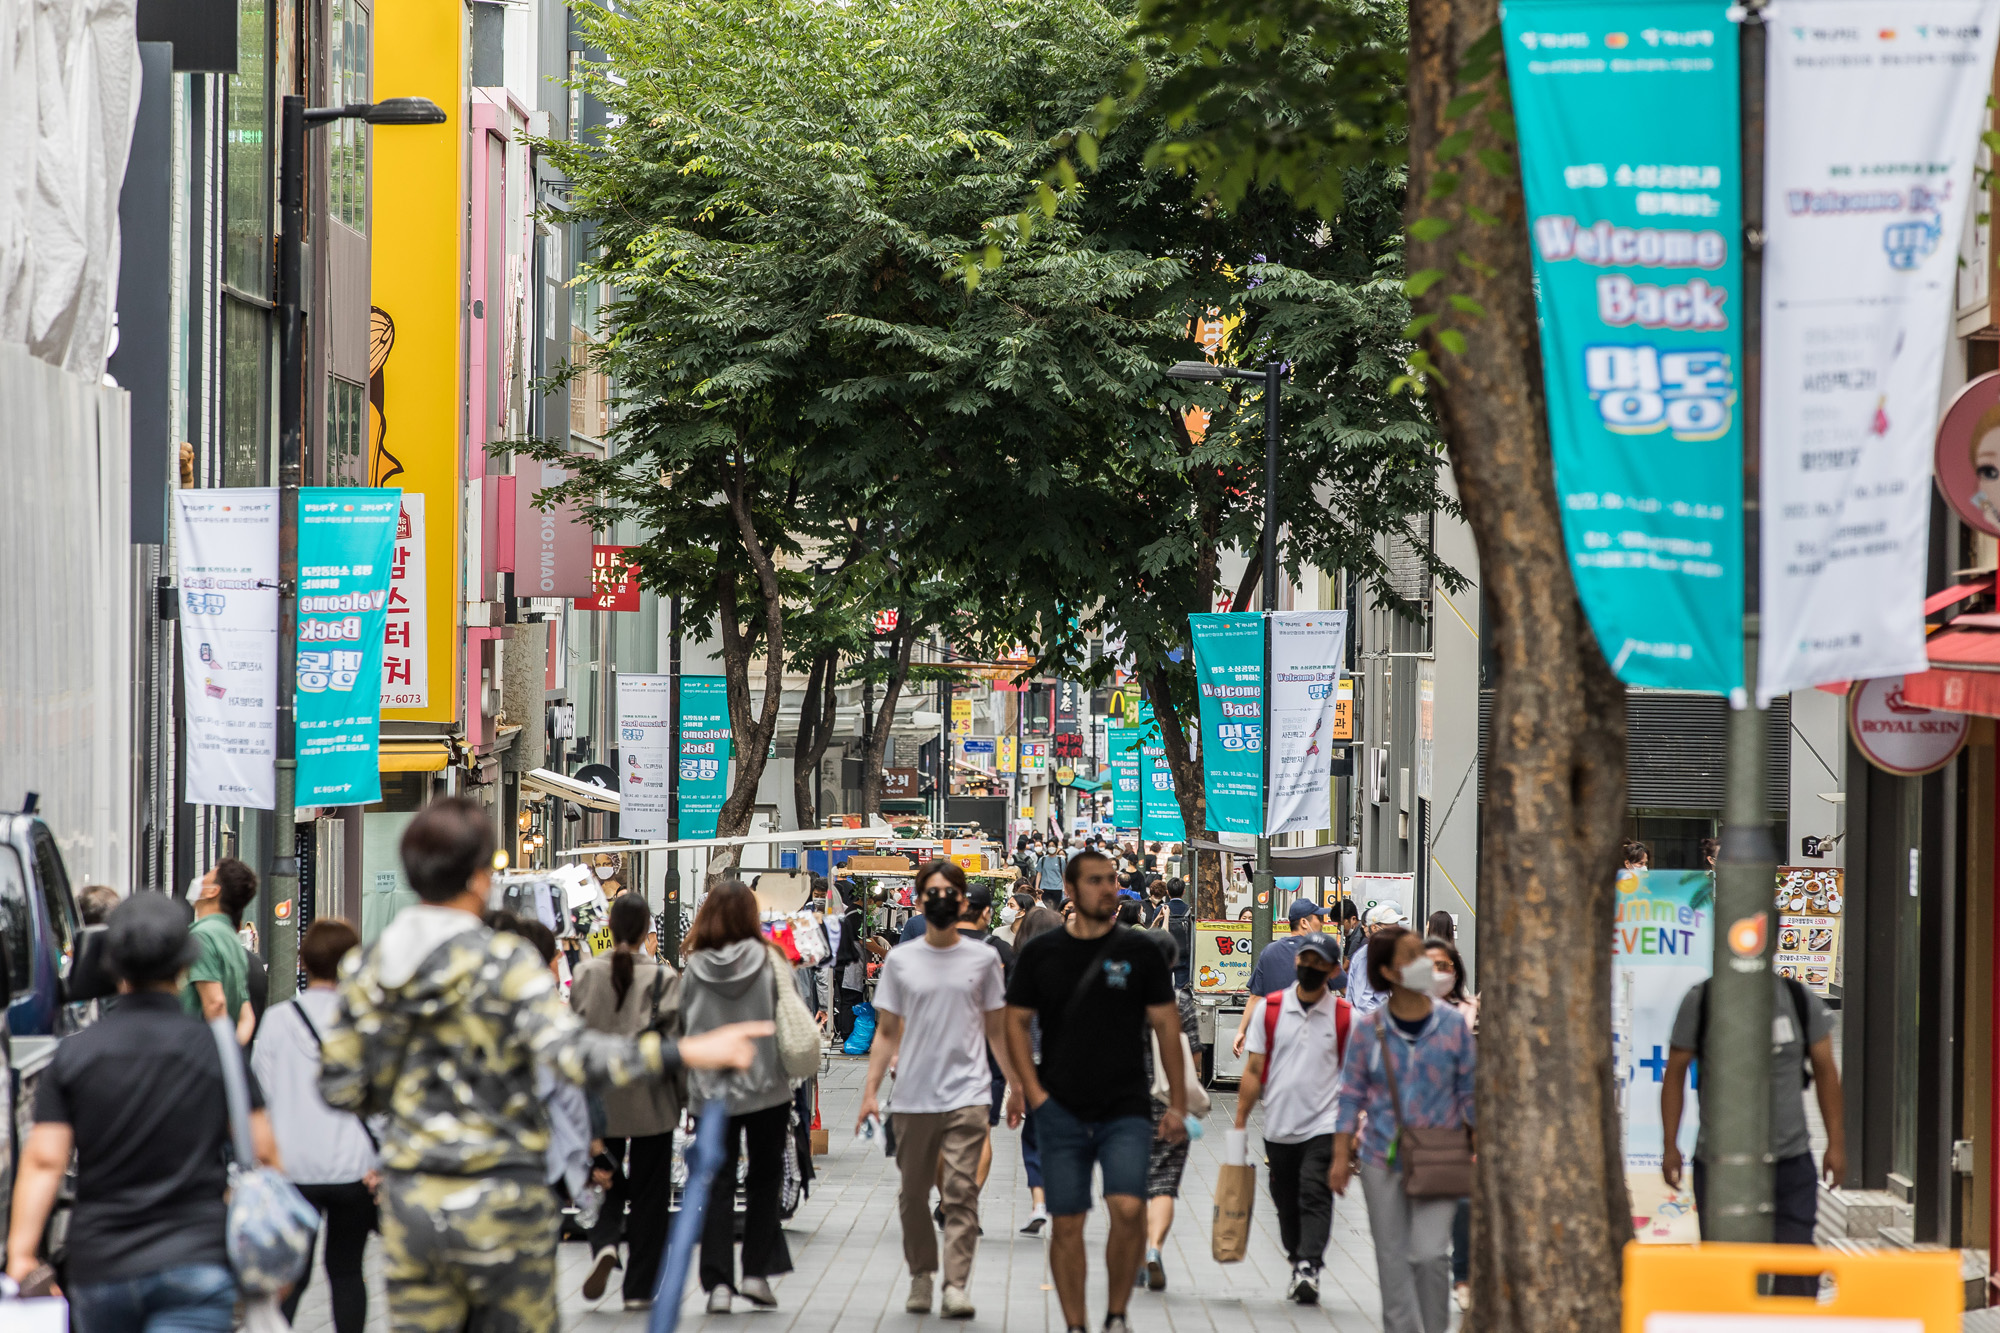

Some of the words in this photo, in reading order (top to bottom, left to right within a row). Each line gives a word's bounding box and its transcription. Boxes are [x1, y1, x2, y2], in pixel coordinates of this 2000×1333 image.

[1533, 214, 1727, 270] Welcome
[1596, 273, 1729, 332] Back
[1584, 342, 1737, 442] 명동
[598, 596, 616, 608] 4F
[1276, 672, 1315, 682] Welcome
[1201, 683, 1261, 698] Welcome
[1221, 701, 1261, 717] Back
[1862, 720, 1916, 733] ROYAL
[1918, 720, 1959, 734] SKIN
[1217, 722, 1262, 753] 명동
[1142, 746, 1166, 756] Welc
[1155, 759, 1170, 768] Ba
[1120, 768, 1139, 776] Back
[1807, 844, 1818, 855] 21
[593, 928, 609, 939] JU
[597, 940, 612, 949] HA
